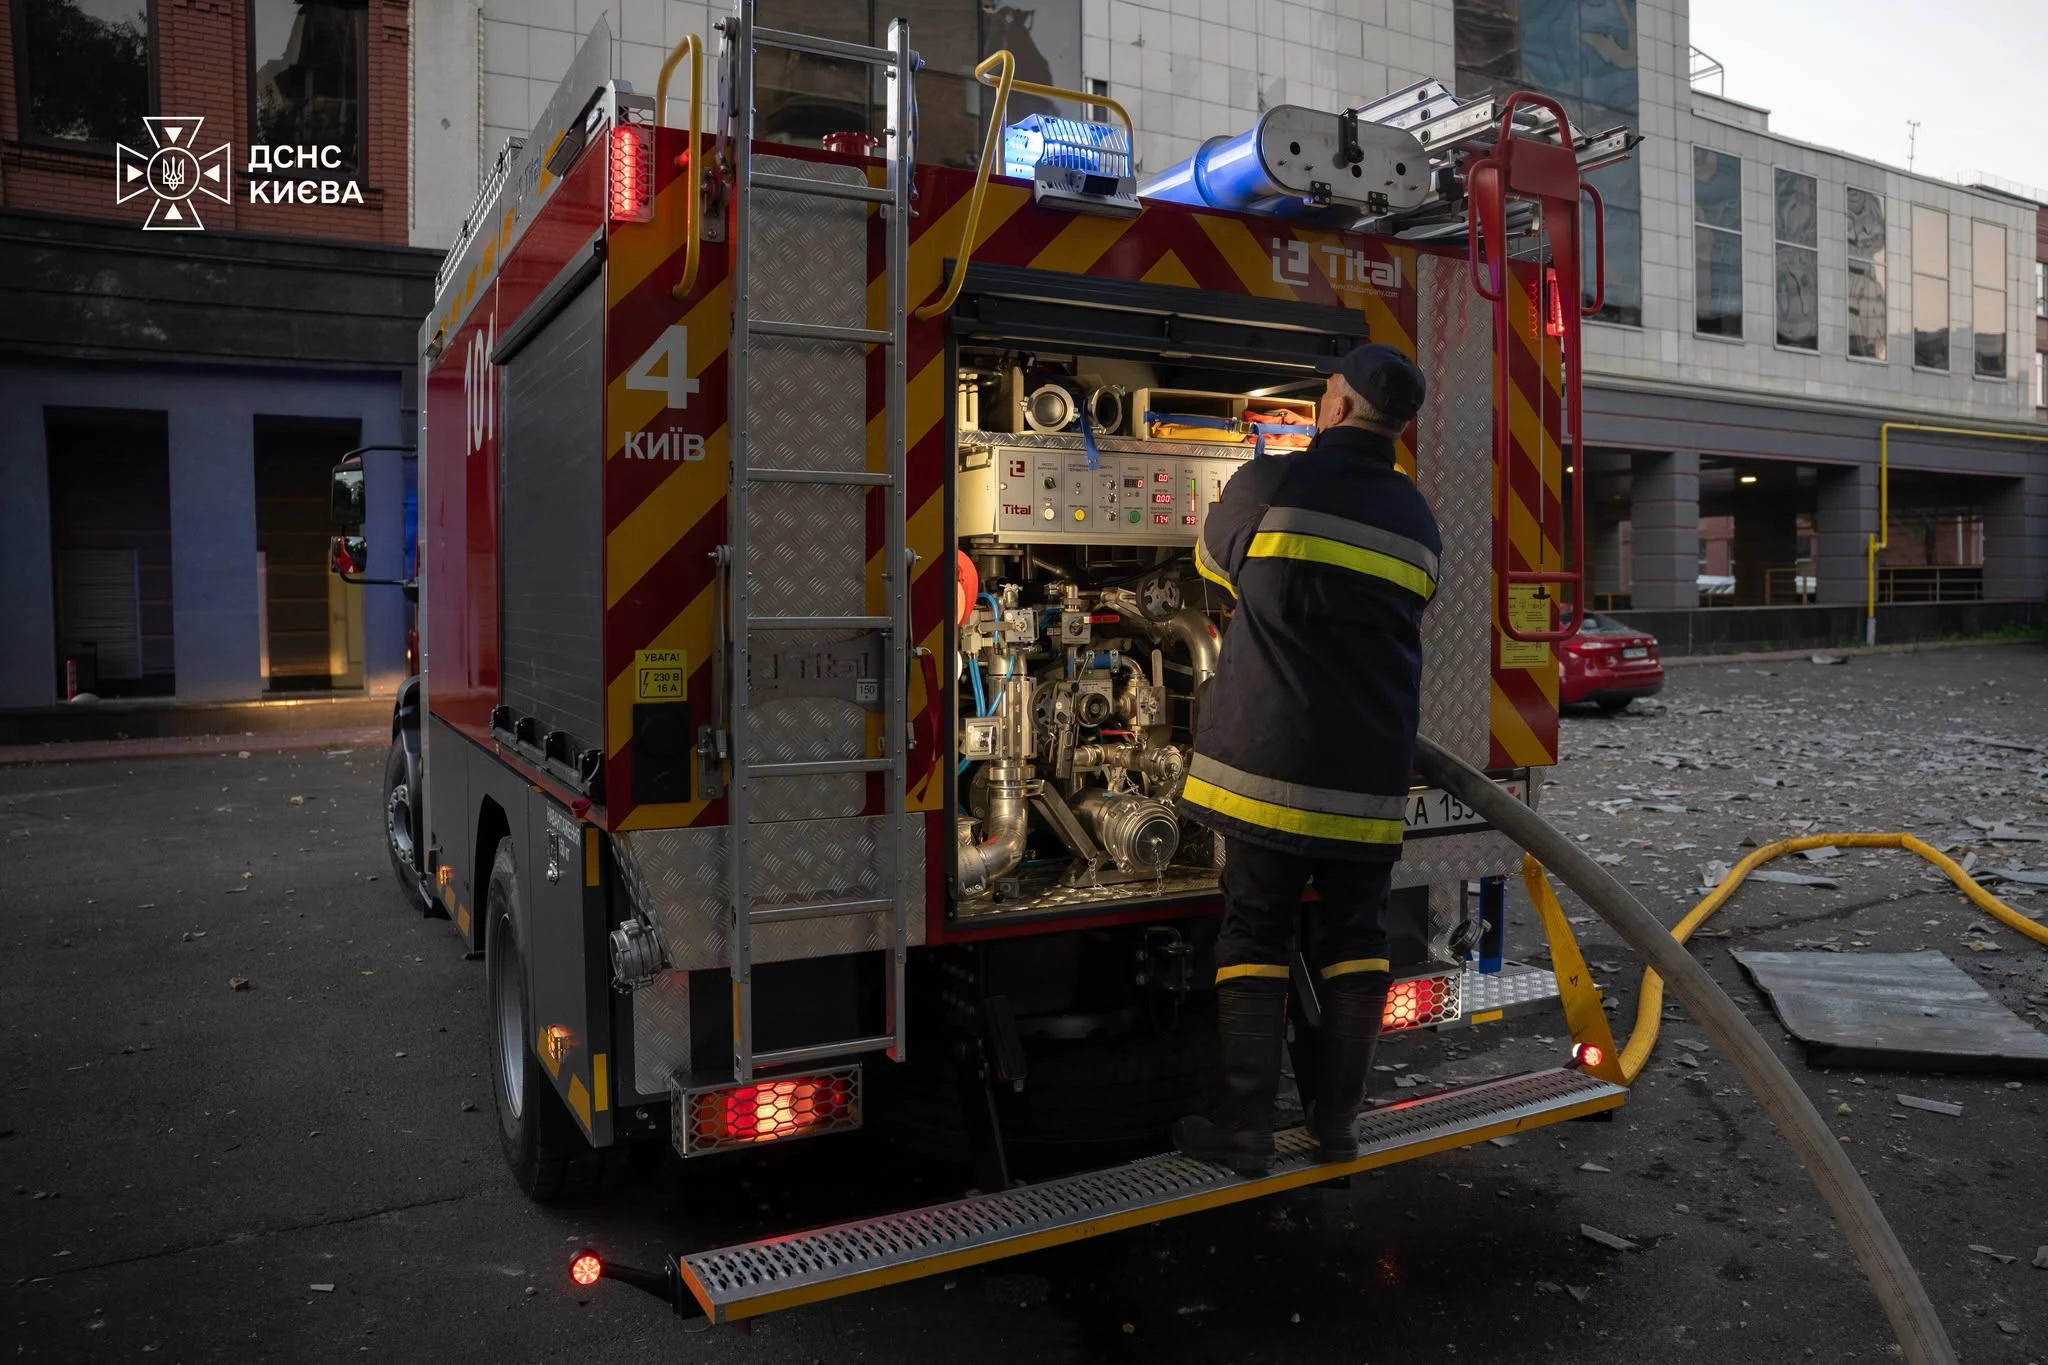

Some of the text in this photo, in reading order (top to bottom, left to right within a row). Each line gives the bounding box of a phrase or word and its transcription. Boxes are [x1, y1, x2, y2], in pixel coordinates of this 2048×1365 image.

[1321, 245, 1401, 288] Tital
[625, 324, 700, 410] 4
[464, 312, 494, 456] 101
[624, 426, 706, 461] КИЇВ
[1003, 504, 1031, 515] Tital
[643, 653, 680, 662] УВАГА!
[653, 673, 670, 682] 230
[657, 684, 668, 693] 16
[860, 684, 875, 696] 150
